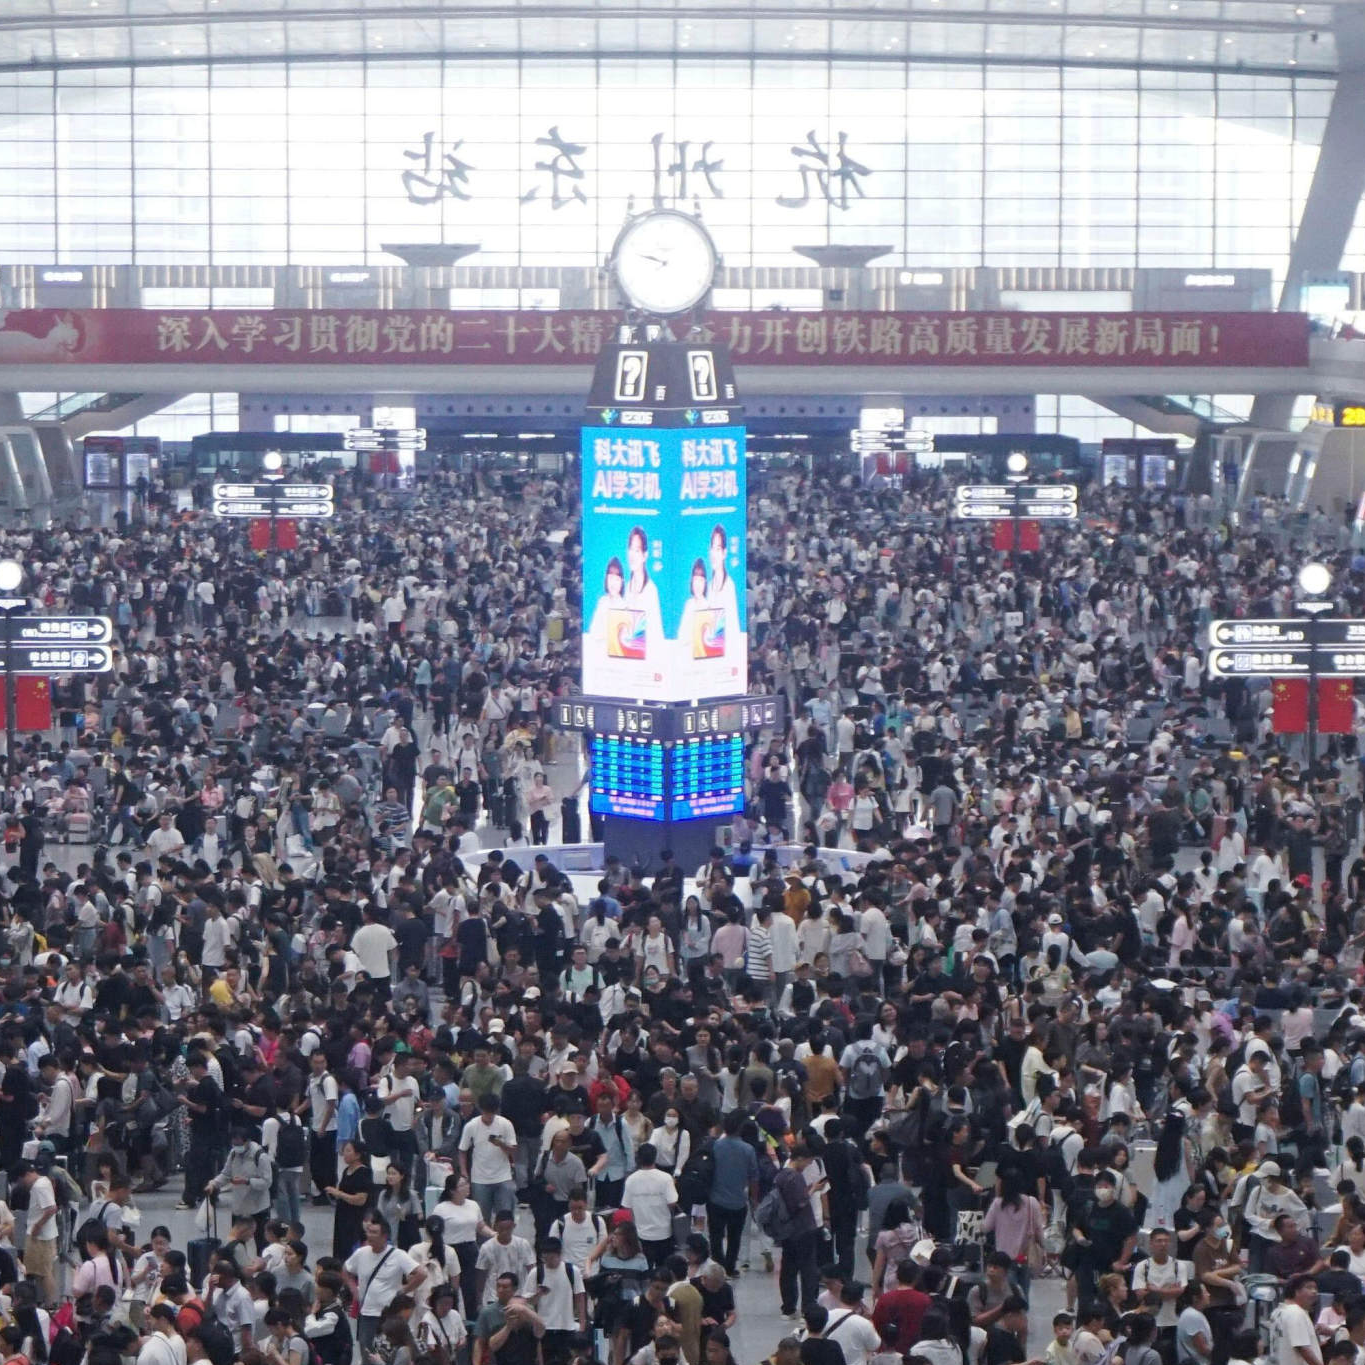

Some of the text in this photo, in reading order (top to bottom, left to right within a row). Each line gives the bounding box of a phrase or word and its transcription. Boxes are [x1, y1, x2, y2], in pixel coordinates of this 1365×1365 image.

[158, 314, 622, 355] 深入学习贯彻党的二十大精
[594, 439, 662, 467] 科大讯飞
[681, 439, 738, 468] 科大讯飞
[592, 471, 662, 500] AI学习机
[679, 471, 738, 500] AI学习机
